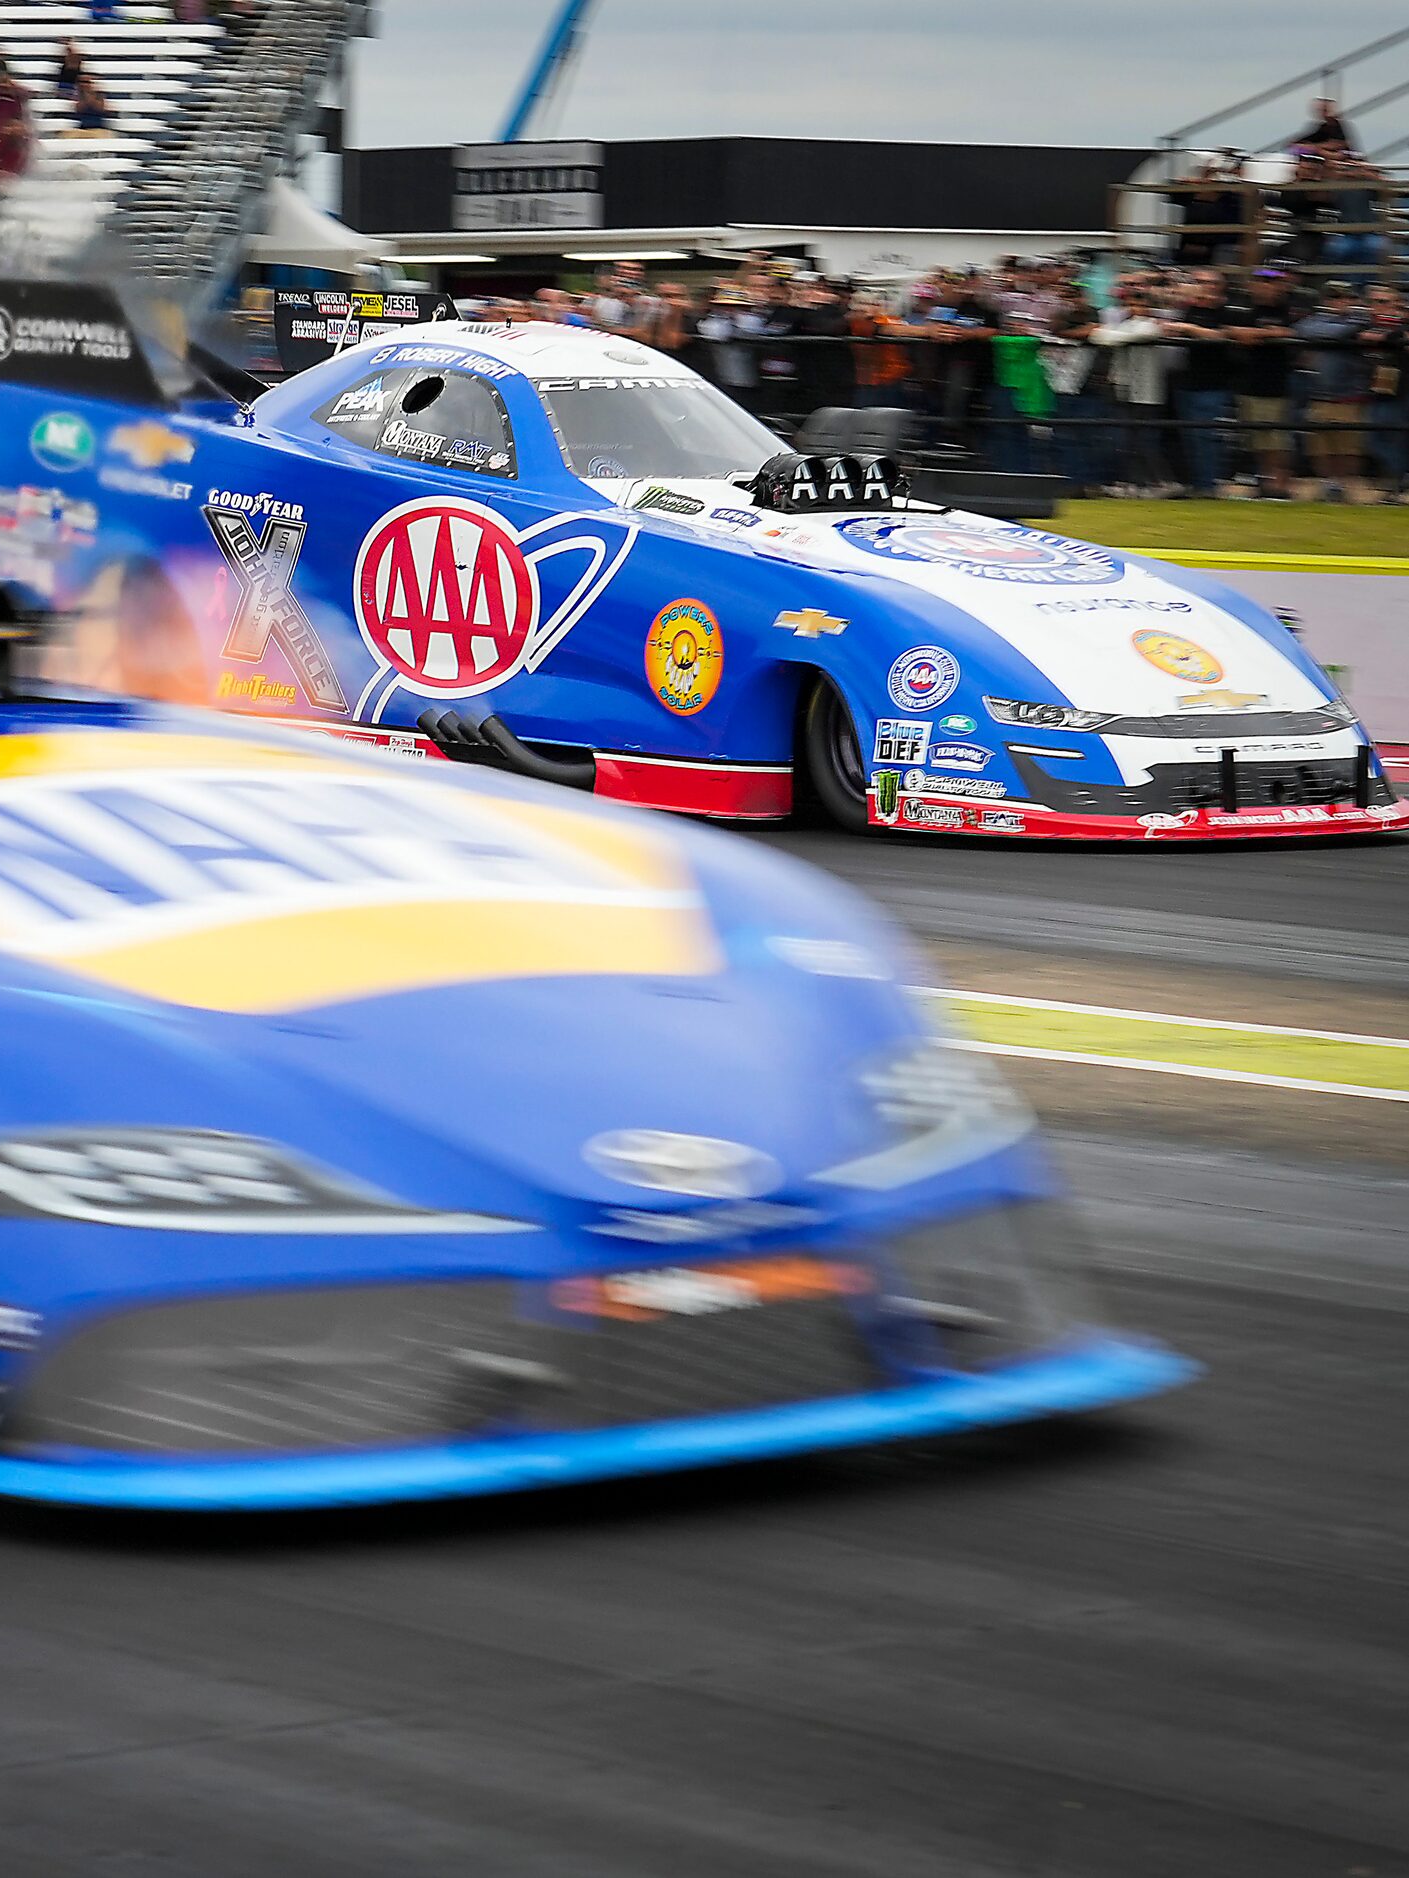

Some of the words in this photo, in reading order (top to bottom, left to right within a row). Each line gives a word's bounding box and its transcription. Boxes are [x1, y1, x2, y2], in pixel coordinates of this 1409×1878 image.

[315, 293, 345, 304] LINCOLN
[385, 296, 418, 311] JESEL
[321, 305, 348, 314] WELDERS
[16, 318, 130, 345] CORNWELL
[291, 329, 327, 339] ABRASIVES
[292, 320, 326, 330] STANDARD
[328, 322, 359, 334] Strage
[14, 337, 76, 354] QUALITY
[81, 342, 132, 360] TOOLS
[370, 347, 397, 365] 8
[392, 347, 464, 365] ROBERT
[457, 354, 519, 380] HIGHT
[331, 390, 393, 414] PEAK
[448, 439, 493, 460] RMT
[224, 523, 280, 598] JOHN
[271, 597, 331, 692] FORCE
[367, 510, 528, 686] AAA
[660, 605, 713, 636] POWERS
[907, 667, 939, 685] AAA
[659, 686, 703, 710] SOLAR
[878, 740, 921, 760] DEF
